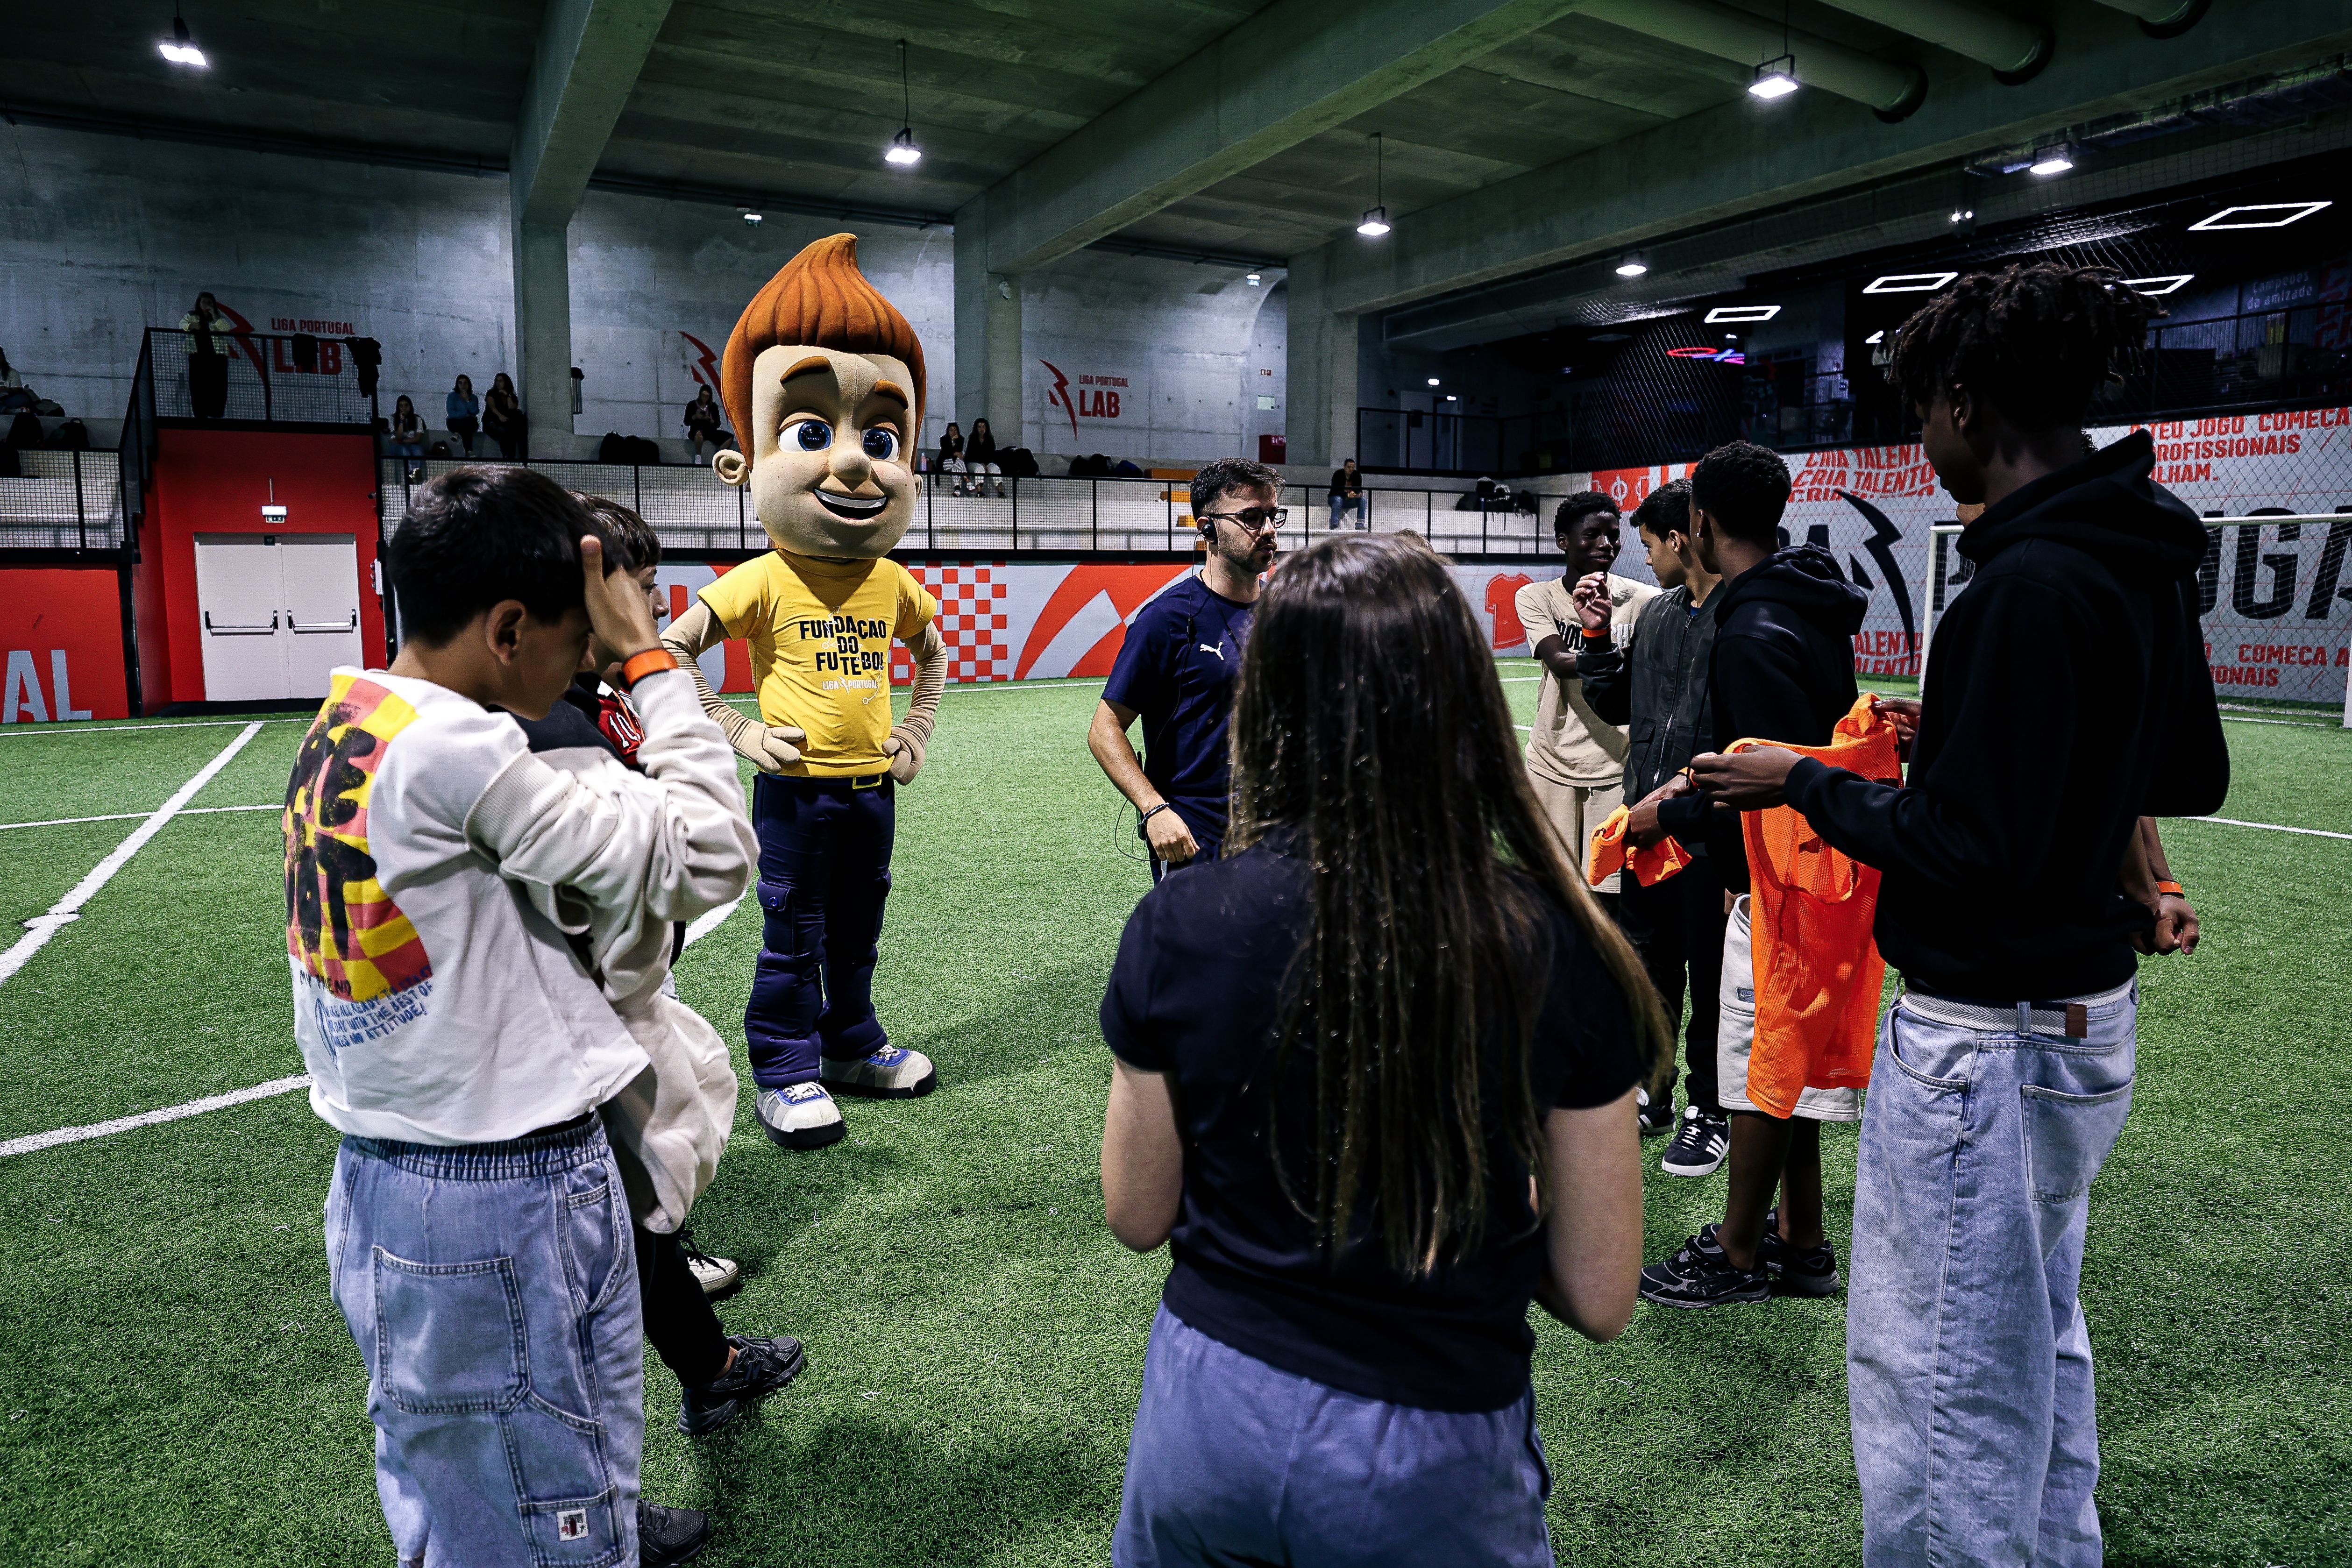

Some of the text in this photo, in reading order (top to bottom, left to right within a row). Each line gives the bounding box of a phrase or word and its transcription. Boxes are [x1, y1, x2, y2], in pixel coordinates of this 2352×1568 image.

[2264, 285, 2312, 305] amizade
[271, 318, 355, 335] LIGA PORTUGAL
[273, 338, 342, 374] LB
[1079, 389, 1120, 418] LAB
[2190, 416, 2245, 438] JOGO
[1851, 444, 1929, 470] TALENT
[2155, 434, 2301, 463] ROFISSIONAIS
[1792, 468, 1847, 488] CRIA
[1854, 461, 1936, 494] TALENTO
[837, 635, 859, 654] DO
[2238, 643, 2327, 667] COMEÇA
[822, 679, 878, 690] LIGA PORTUGAL
[366, 1006, 391, 1025] THE
[390, 990, 419, 1013] BEST
[418, 980, 433, 997] OF
[365, 1002, 427, 1041] ATTITUDE!
